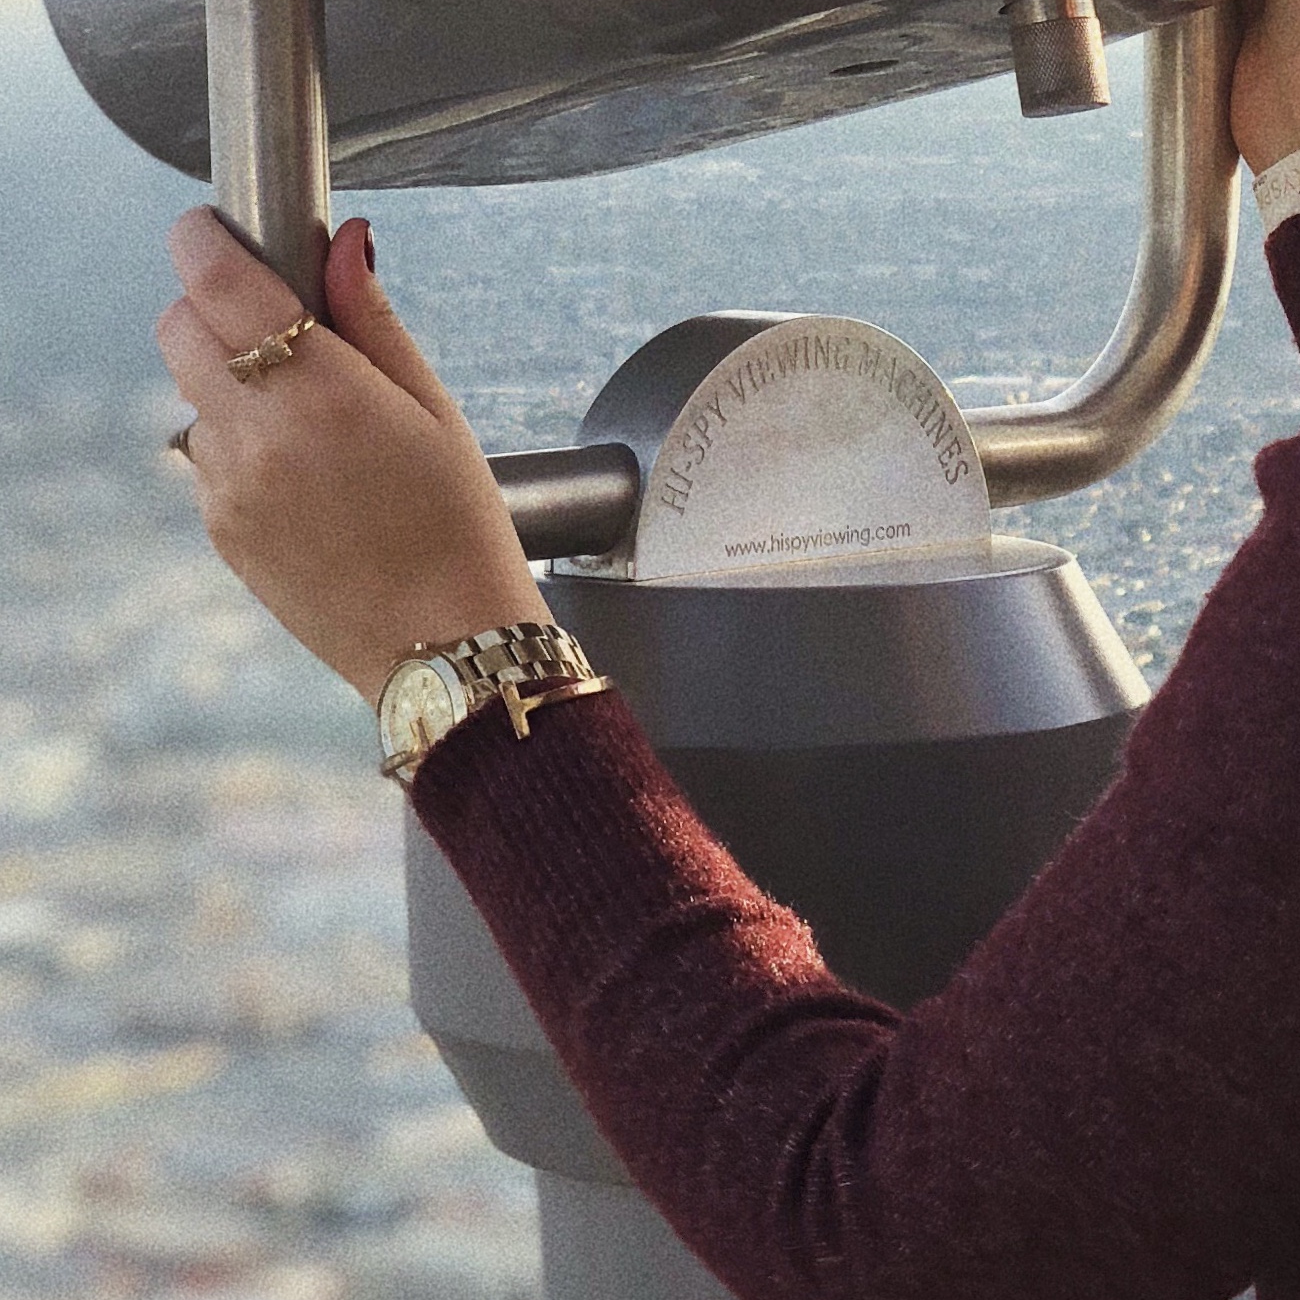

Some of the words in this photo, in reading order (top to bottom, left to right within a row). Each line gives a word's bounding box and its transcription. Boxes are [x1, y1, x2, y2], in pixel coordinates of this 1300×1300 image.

[660, 391, 728, 517] HI-SPY
[725, 334, 851, 405] VIEWING
[857, 341, 969, 485] MACHINES
[724, 522, 911, 558] www.hispyviewing.com
